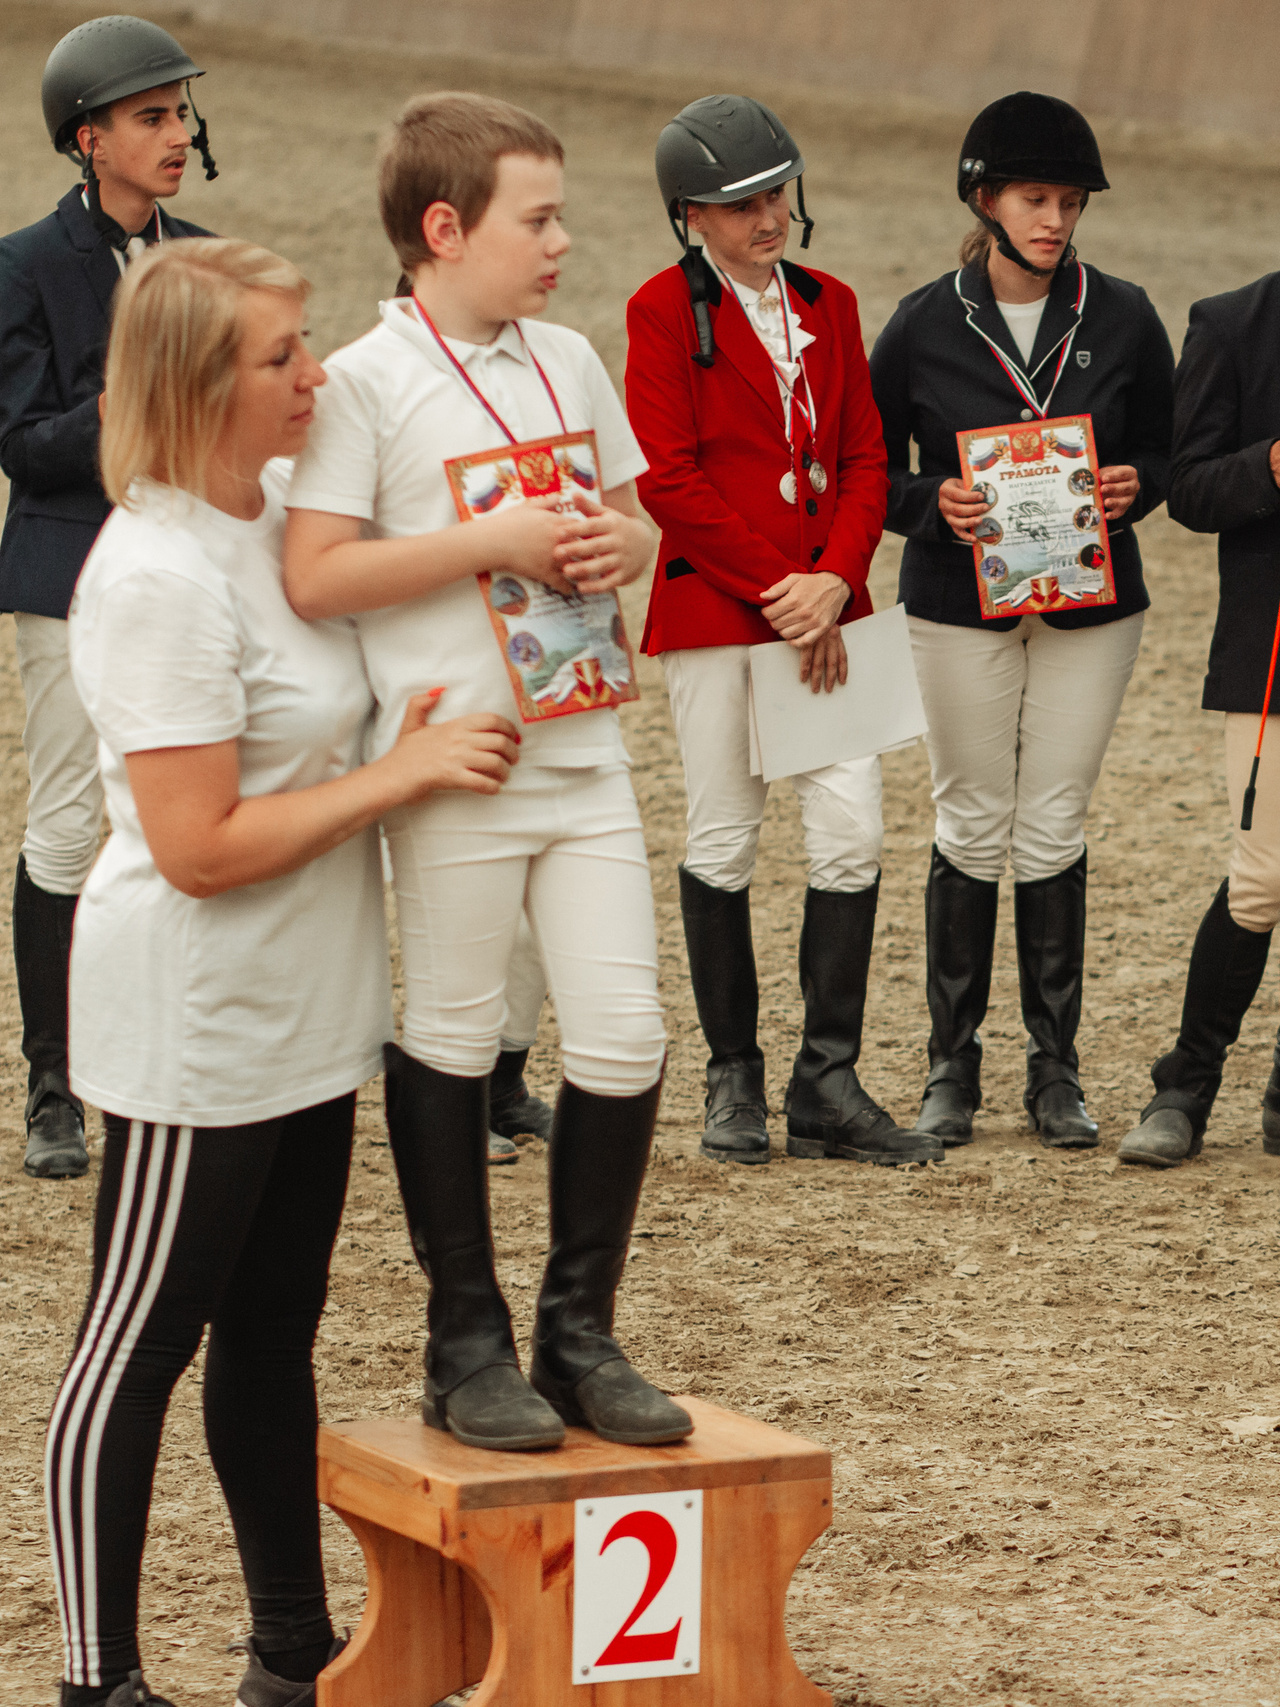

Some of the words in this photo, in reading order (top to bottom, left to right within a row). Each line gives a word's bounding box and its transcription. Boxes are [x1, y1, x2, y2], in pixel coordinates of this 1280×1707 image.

[998, 464, 1061, 481] ГРАМОТА
[1008, 478, 1057, 489] НАГРАЖДАЕТСЯ
[594, 1510, 683, 1667] 2
